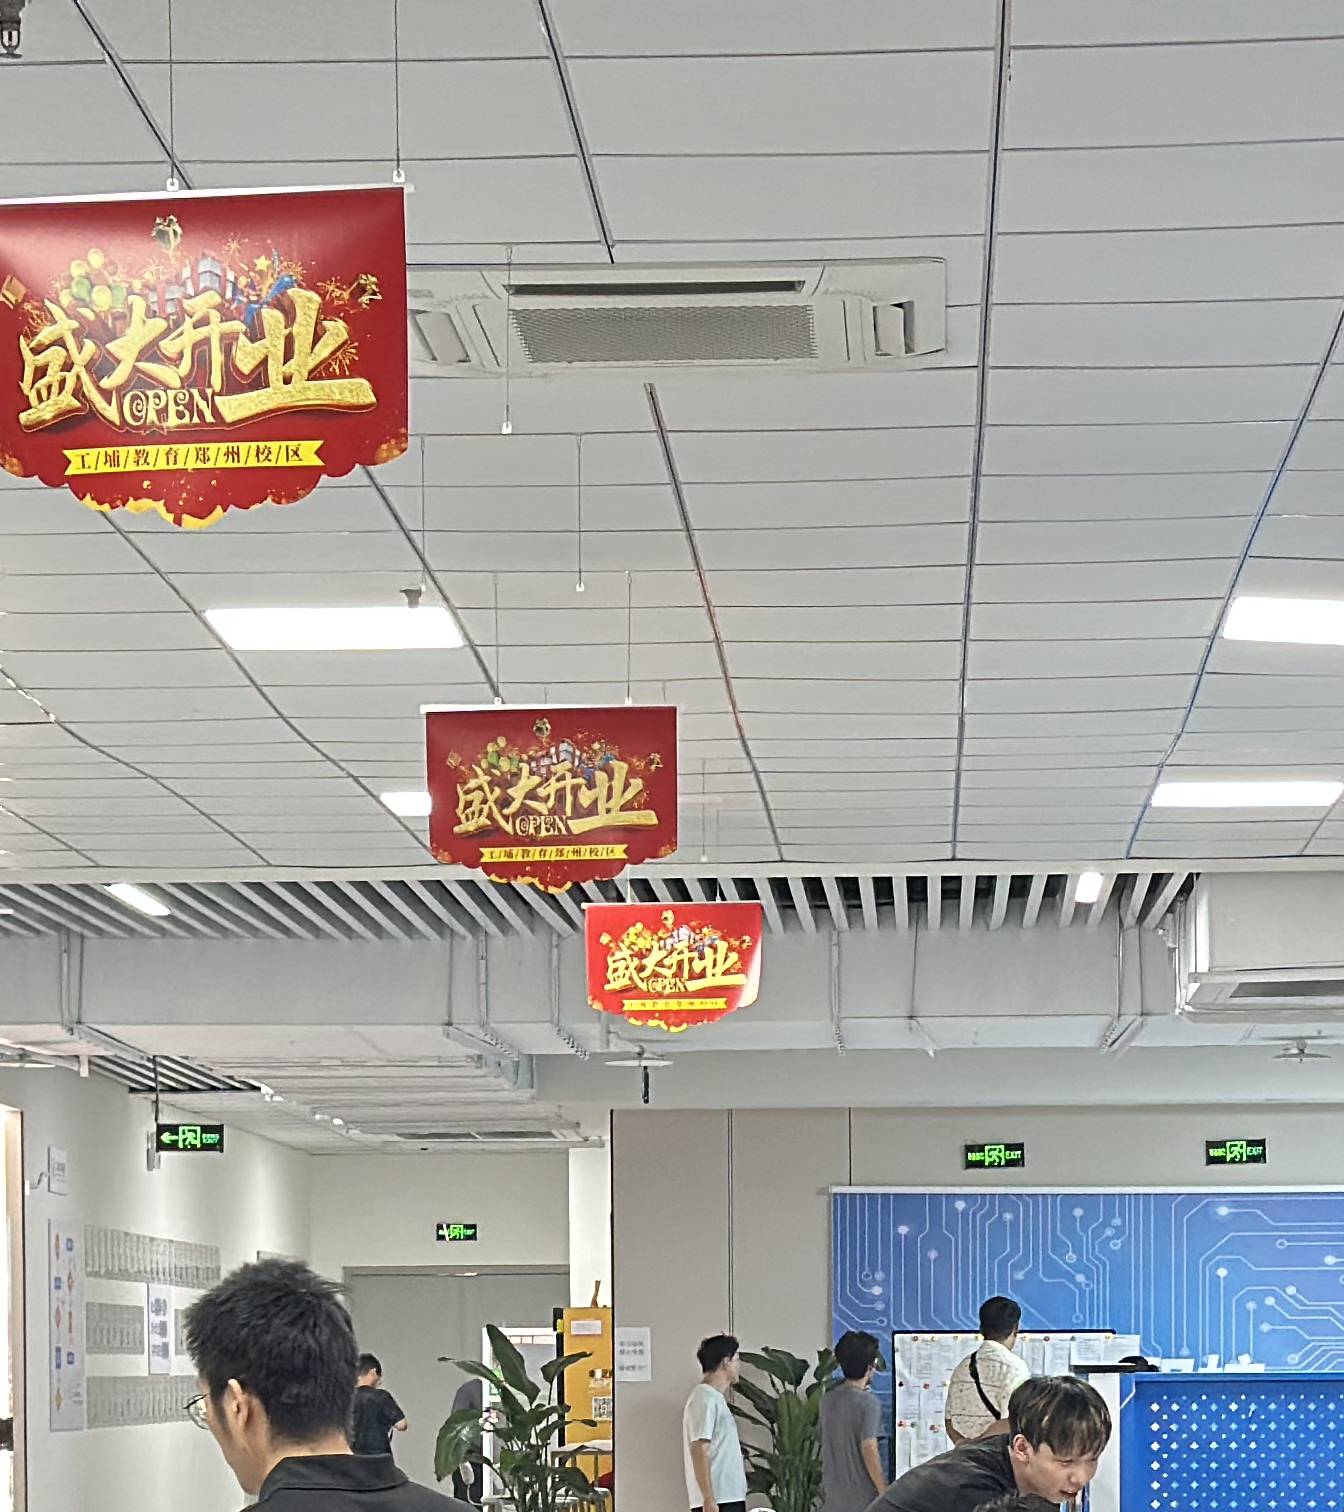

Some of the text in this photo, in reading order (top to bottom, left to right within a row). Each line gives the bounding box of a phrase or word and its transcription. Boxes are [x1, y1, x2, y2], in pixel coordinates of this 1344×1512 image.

[19, 287, 377, 429] 盛大开业
[122, 388, 216, 427] OPEN
[453, 760, 659, 836] 盛大开业
[514, 815, 570, 837] OPEN
[603, 940, 748, 992] 盛大开业
[647, 977, 689, 993] OPEN
